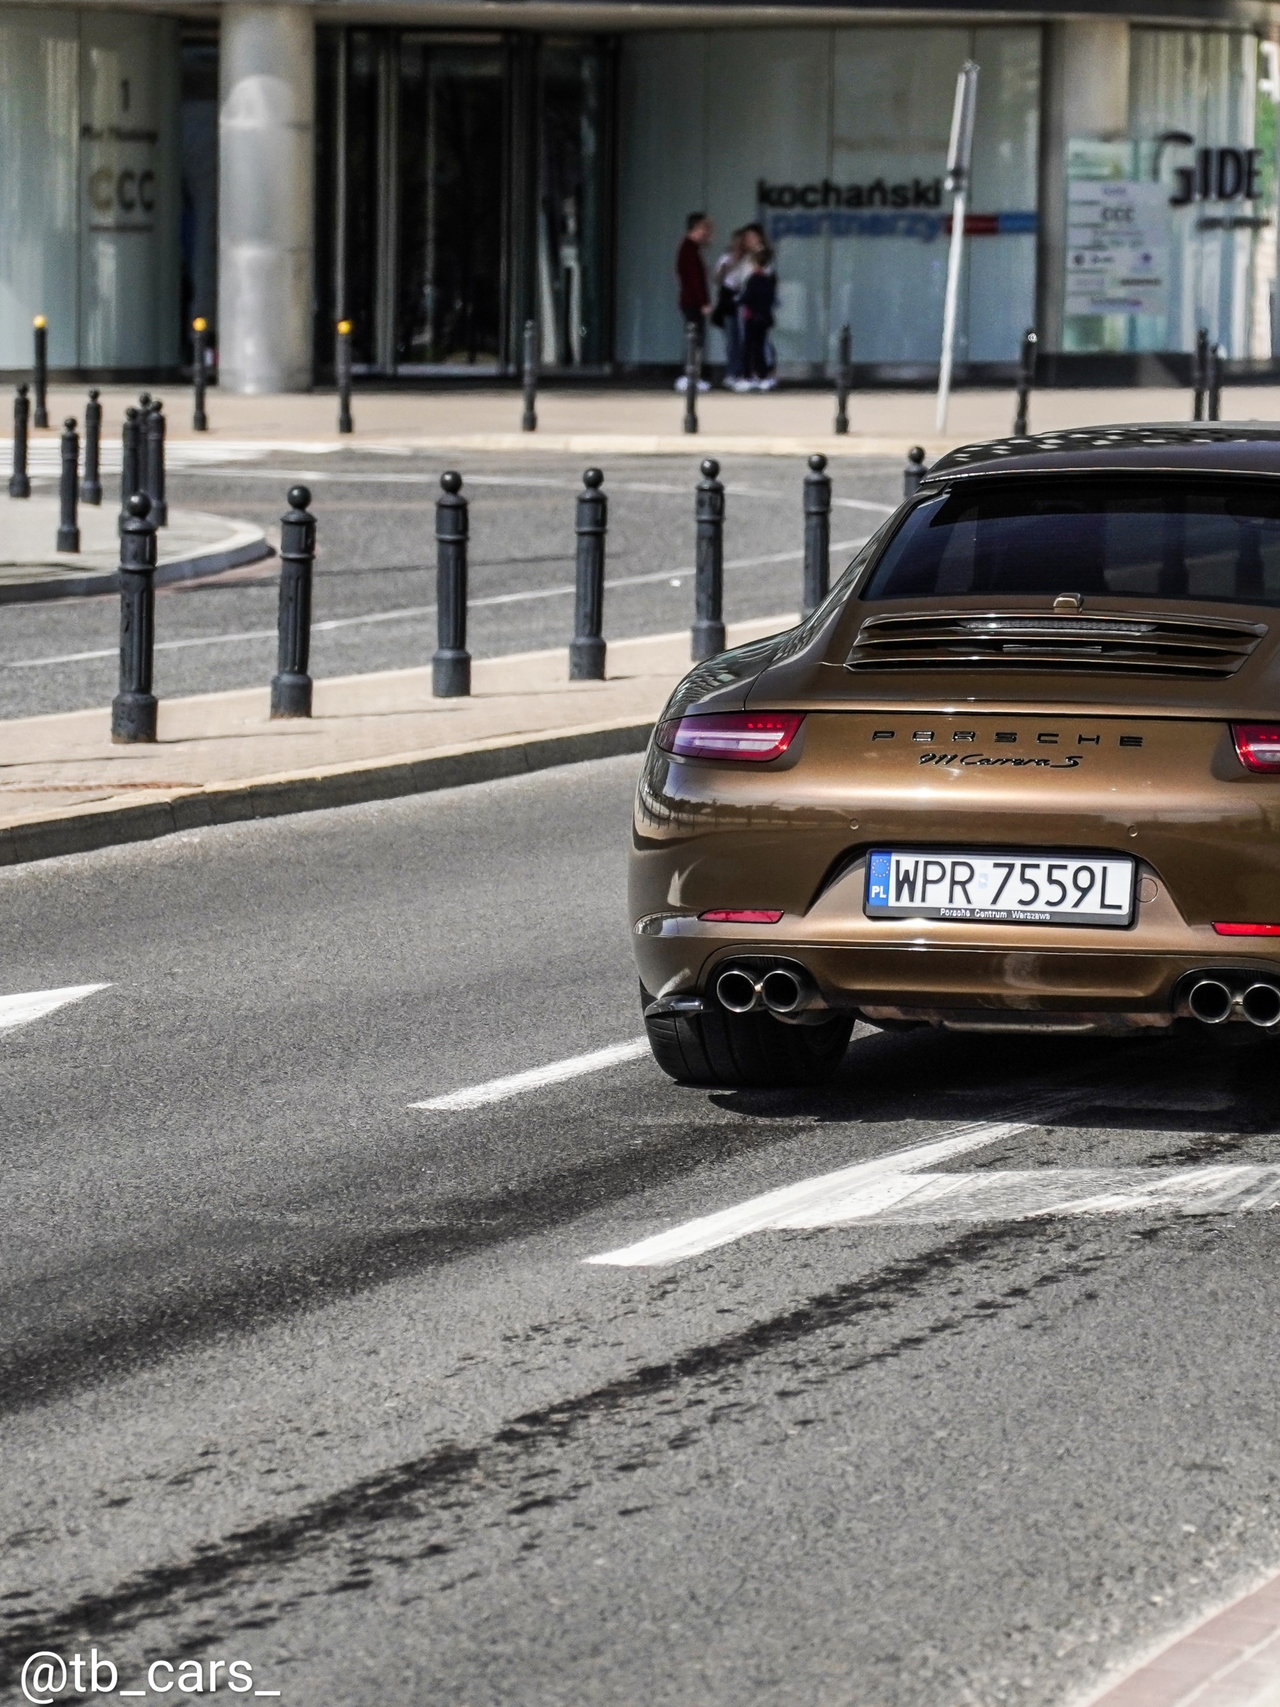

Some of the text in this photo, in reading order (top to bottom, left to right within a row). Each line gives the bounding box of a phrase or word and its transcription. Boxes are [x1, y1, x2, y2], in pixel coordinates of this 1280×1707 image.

[1153, 131, 1263, 208] GIDE
[88, 165, 154, 214] CCC
[757, 177, 942, 209] kochański
[872, 730, 1143, 747] PORSCHE
[919, 753, 1083, 768] 911 Carrera S
[871, 885, 887, 898] PL
[895, 859, 1123, 911] WPR 7559L
[940, 908, 1051, 920] Porsche Centrum Warszawa
